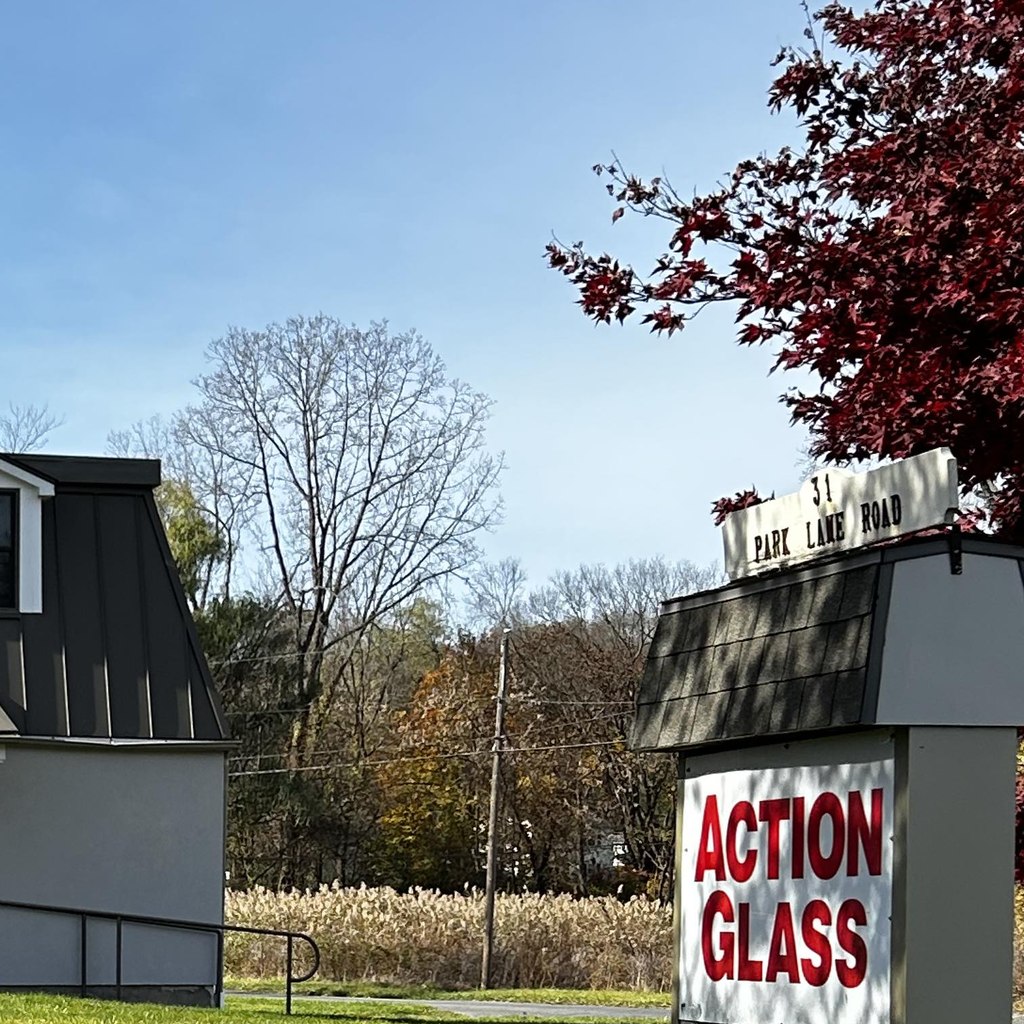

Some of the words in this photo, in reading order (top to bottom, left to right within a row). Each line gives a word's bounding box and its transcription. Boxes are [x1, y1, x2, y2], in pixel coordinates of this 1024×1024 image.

[754, 527, 790, 563] PARK
[860, 494, 902, 534] ROAD
[811, 474, 832, 507] 31
[694, 788, 884, 883] ACTION
[701, 890, 868, 989] GLASS
